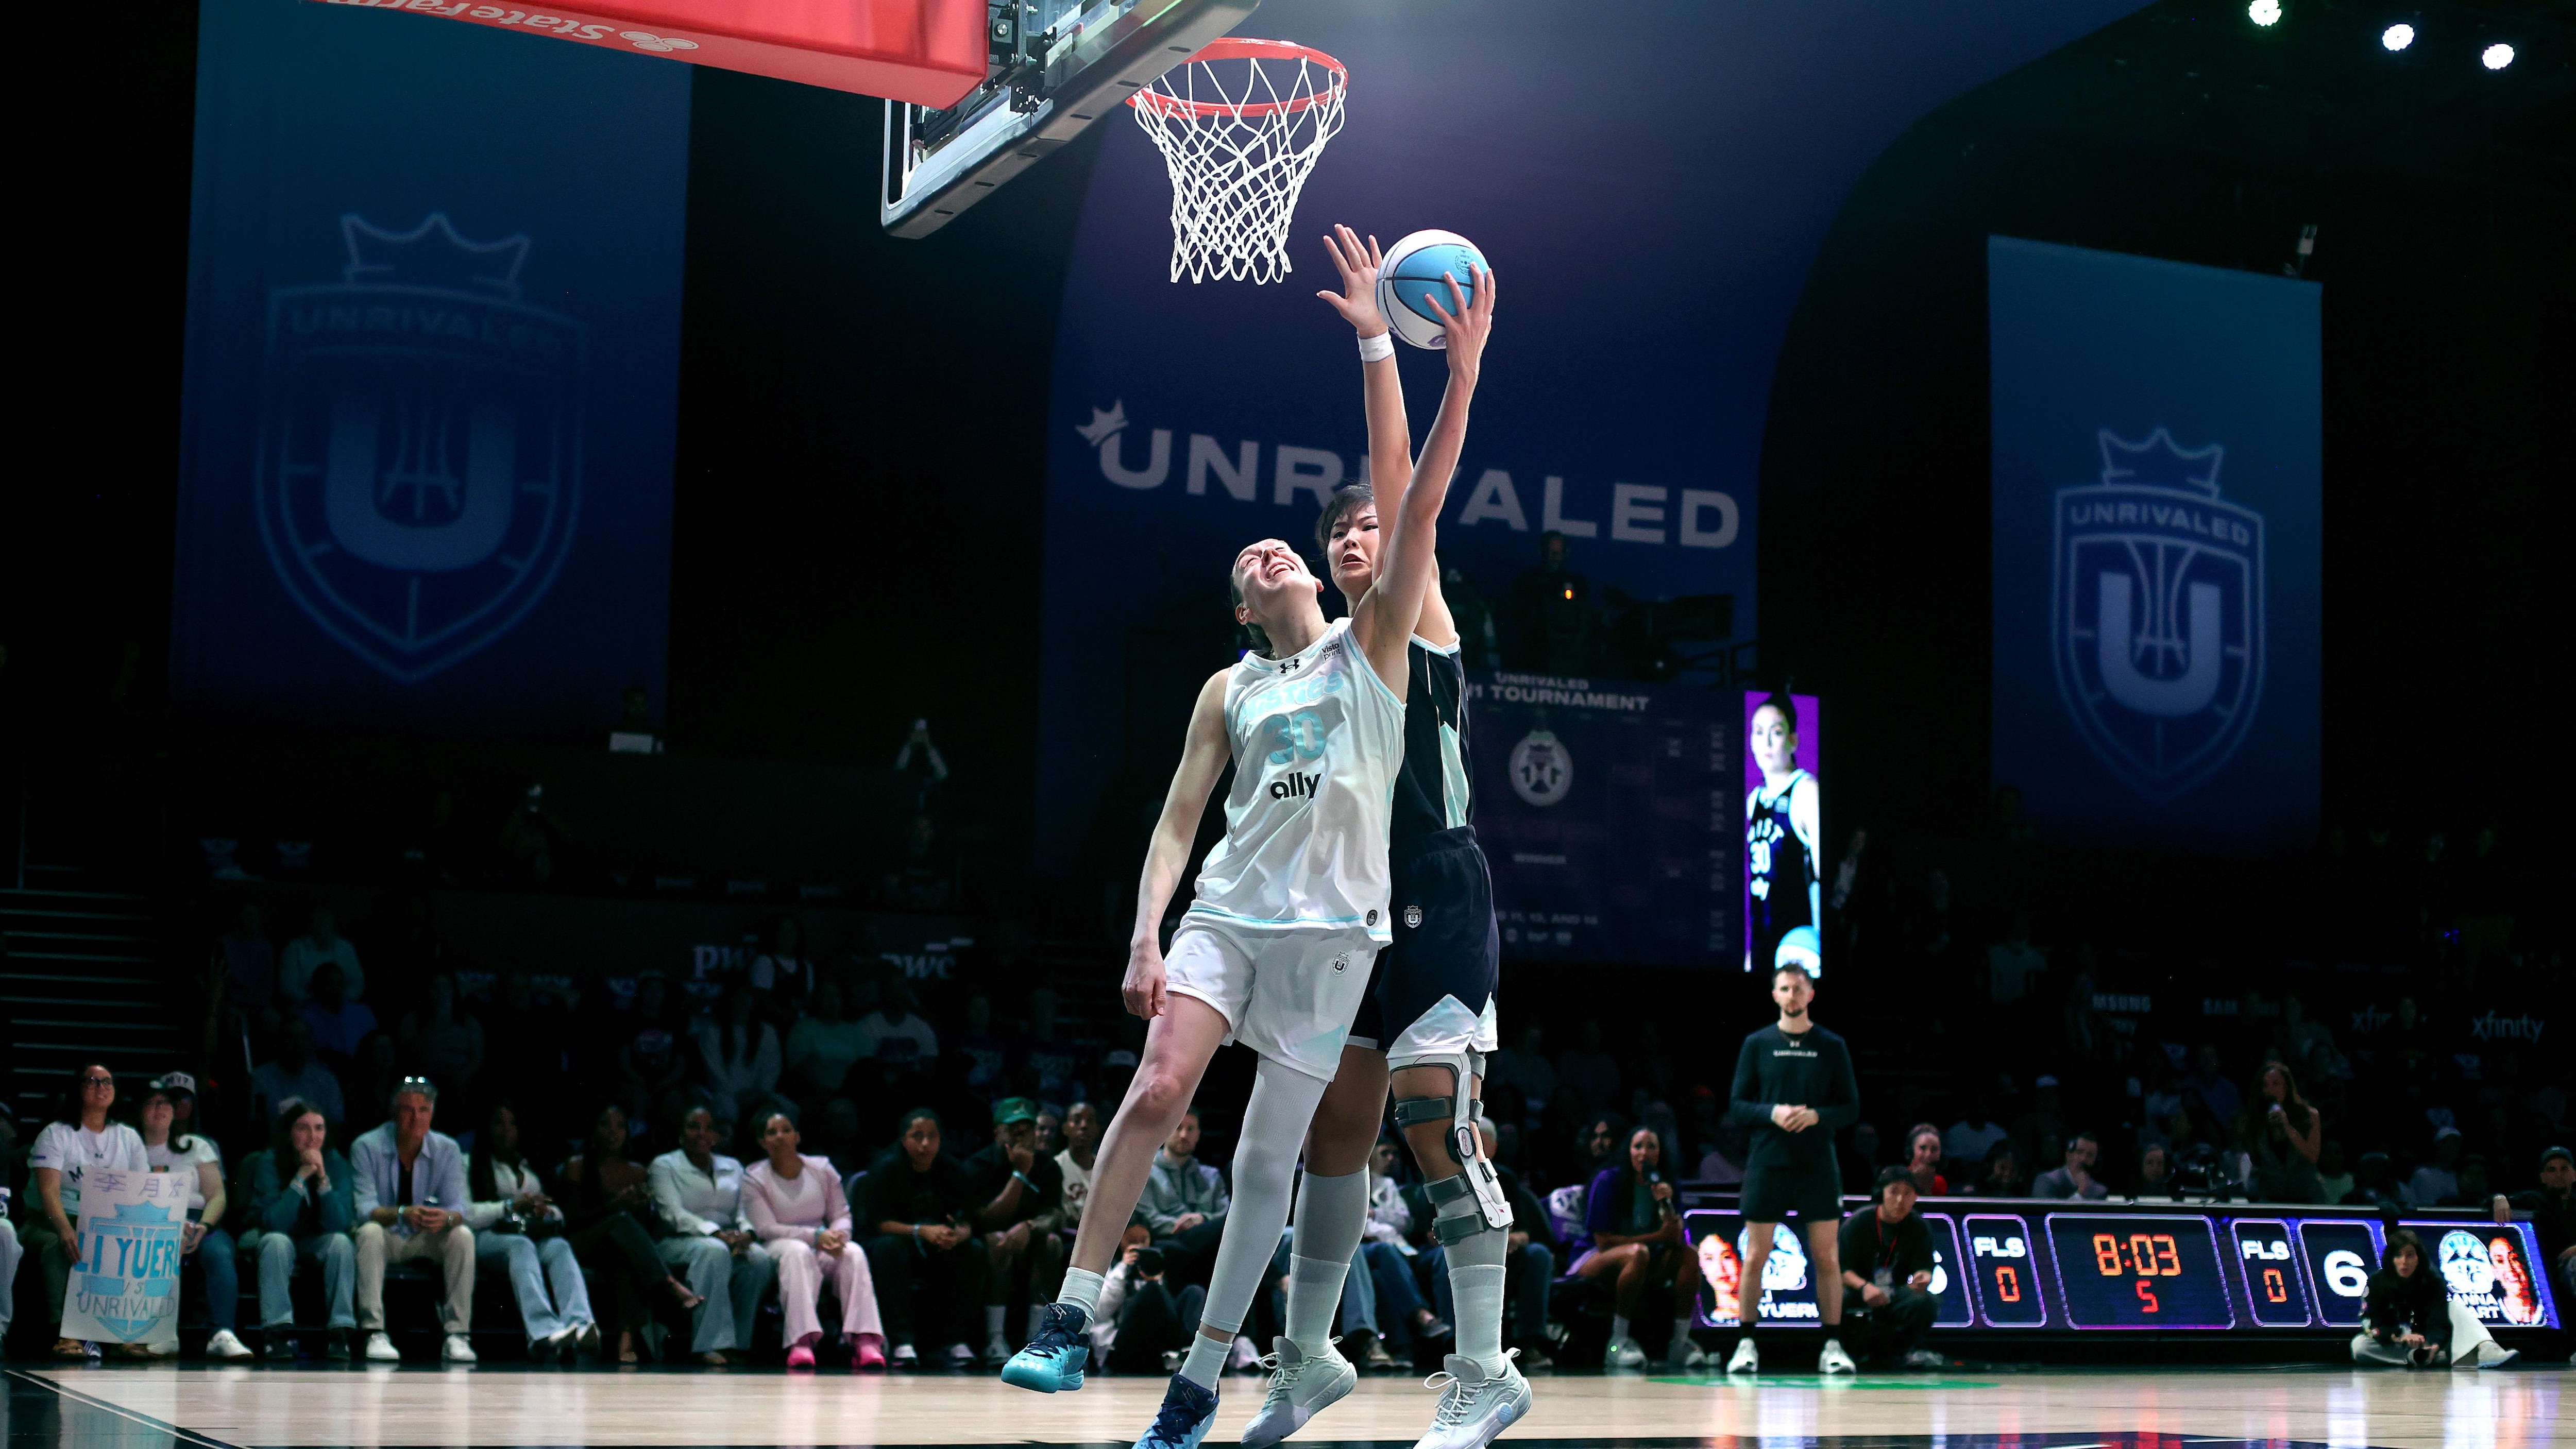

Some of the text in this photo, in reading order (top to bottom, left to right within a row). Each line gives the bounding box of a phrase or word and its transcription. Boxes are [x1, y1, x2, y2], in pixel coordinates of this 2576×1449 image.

[1099, 428, 1741, 549] UNRALED
[2070, 501, 2250, 547] UNRIVALED
[1321, 643, 1340, 653] vista
[1324, 649, 1341, 661] print
[2098, 571, 2222, 716] U
[1490, 684, 1650, 711] TOURNAMENT
[1264, 710, 1328, 764] 30
[1269, 772, 1322, 799] ally
[692, 944, 756, 980] pw
[2093, 993, 2152, 1013] MSUNG
[2470, 1008, 2546, 1045] xfinity
[1973, 1236, 2026, 1258] FLS
[2093, 1233, 2182, 1276] 8:03
[2241, 1239, 2291, 1260] FLS
[1995, 1265, 2021, 1303] 0
[2263, 1268, 2287, 1303] 0
[2323, 1249, 2369, 1297] 6
[2135, 1279, 2159, 1313] 5
